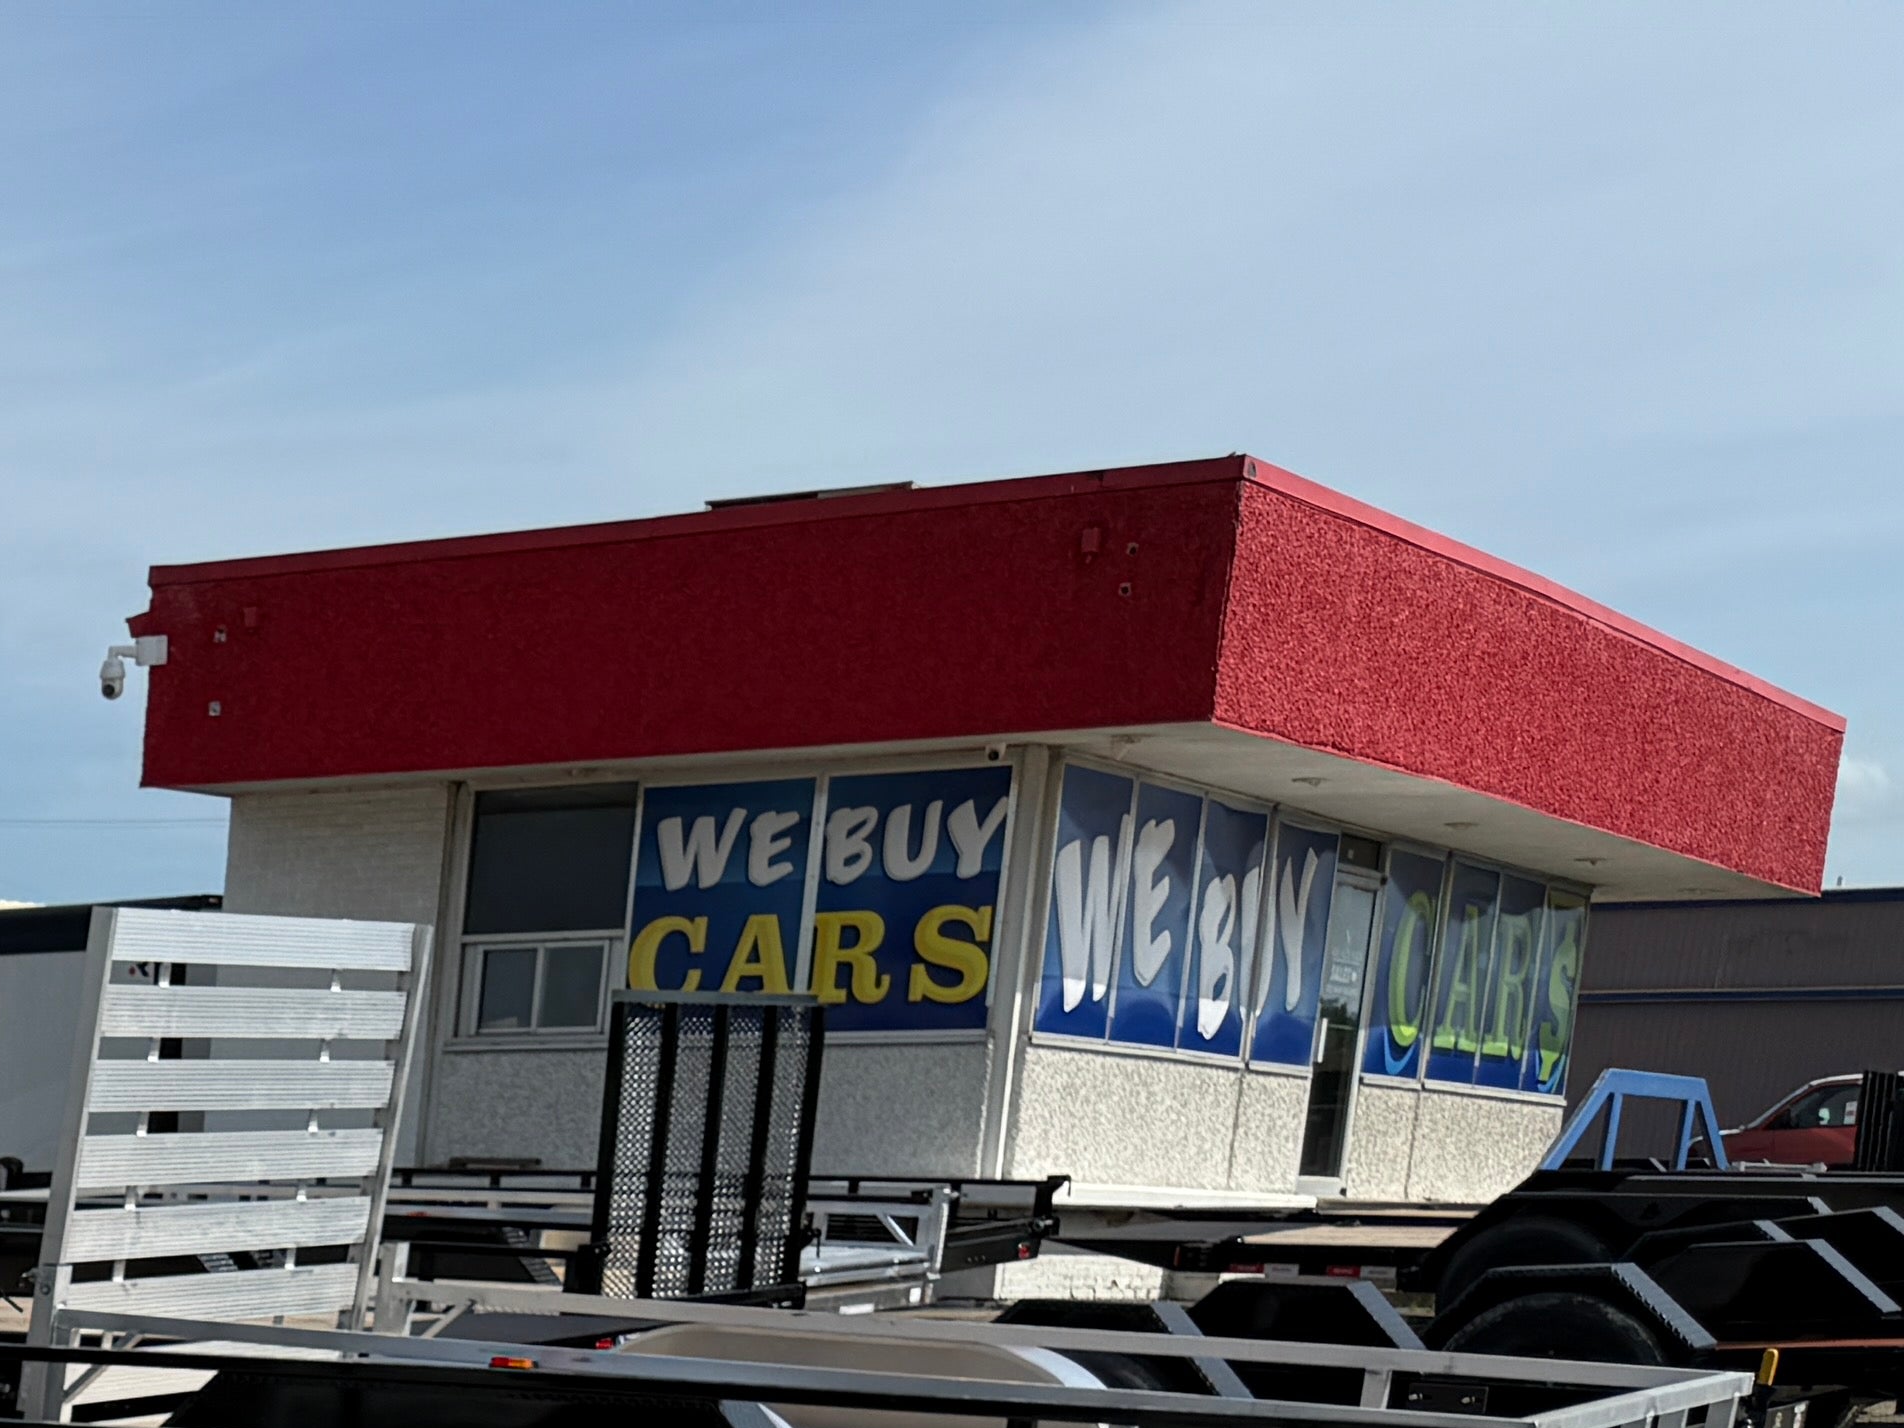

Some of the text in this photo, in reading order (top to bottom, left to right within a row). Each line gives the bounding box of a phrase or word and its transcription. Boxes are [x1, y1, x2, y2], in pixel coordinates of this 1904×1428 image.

[656, 796, 1009, 892] WE BUY
[627, 904, 993, 1005] CARS
[1055, 813, 1319, 1041] WE BUY
